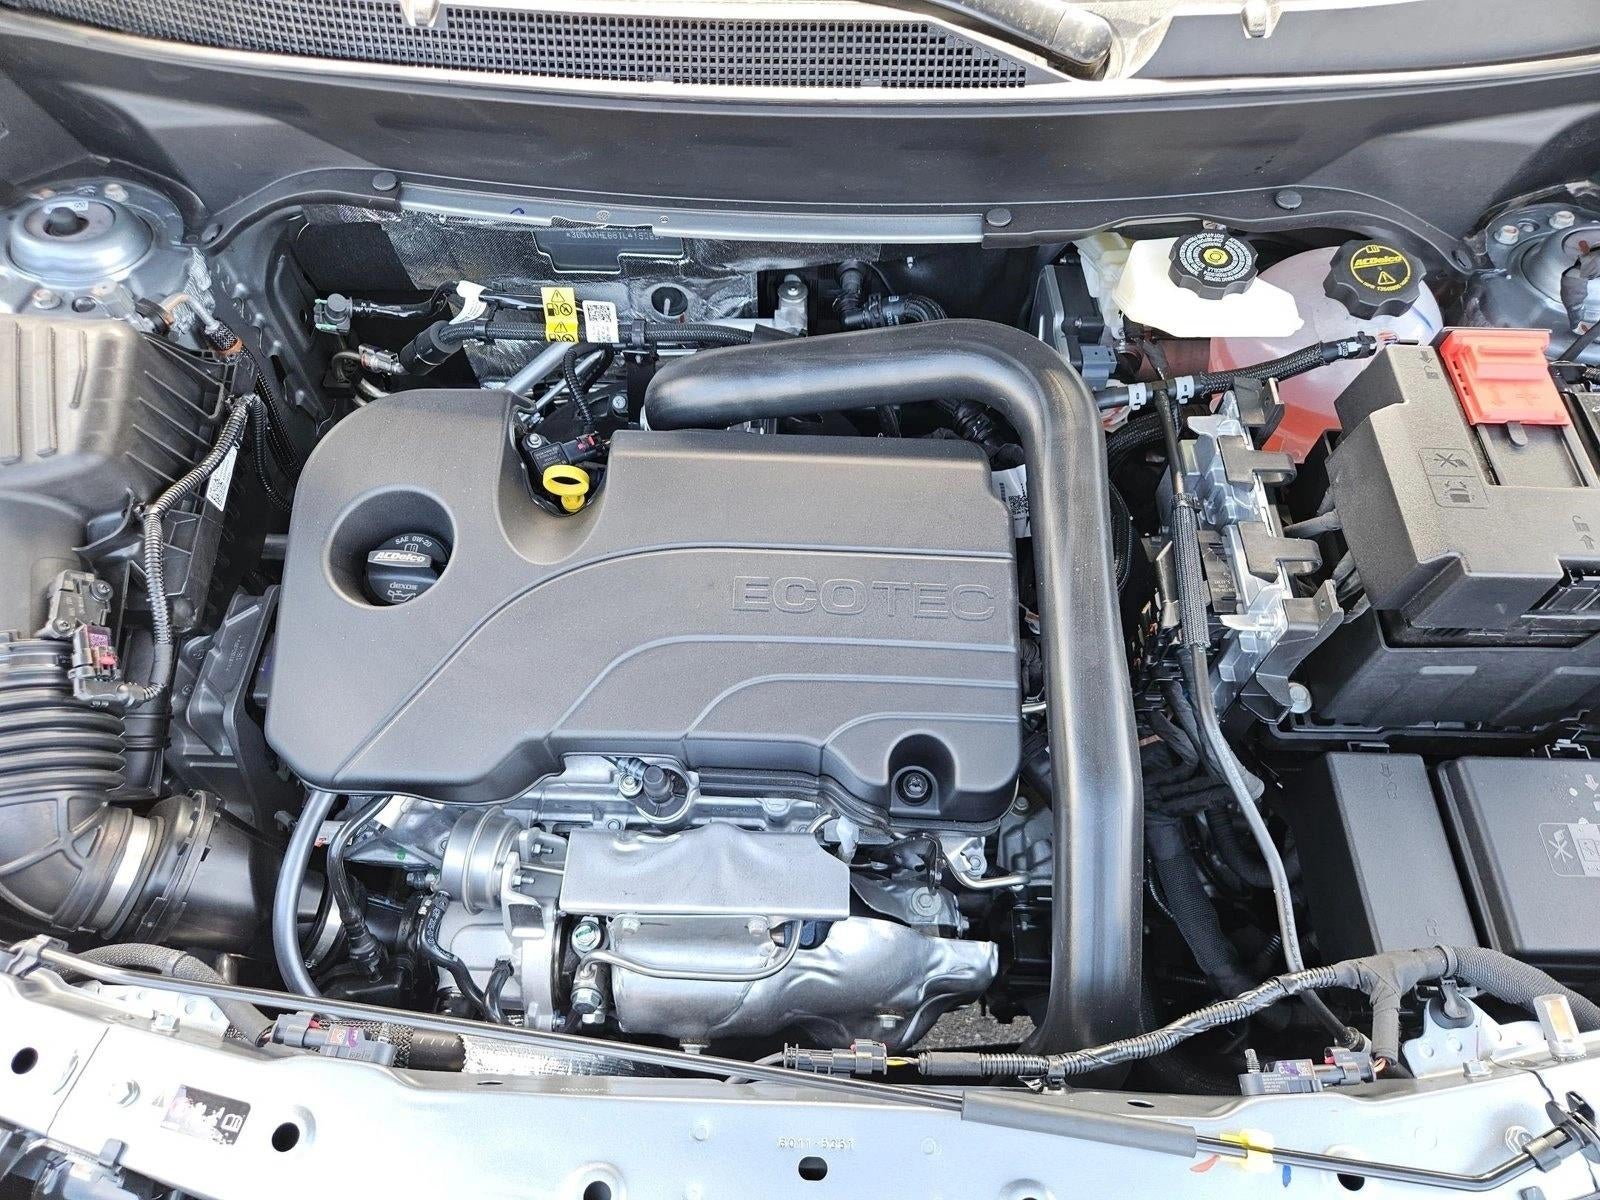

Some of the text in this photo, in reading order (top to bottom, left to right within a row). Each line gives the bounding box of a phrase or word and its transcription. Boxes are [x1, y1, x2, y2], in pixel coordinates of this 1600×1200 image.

[1354, 256, 1403, 268] ACDelco
[395, 536, 432, 548] SAE 0W-20
[373, 552, 426, 563] ACDelco
[389, 581, 418, 590] dexos
[733, 576, 995, 622] ECOTEC
